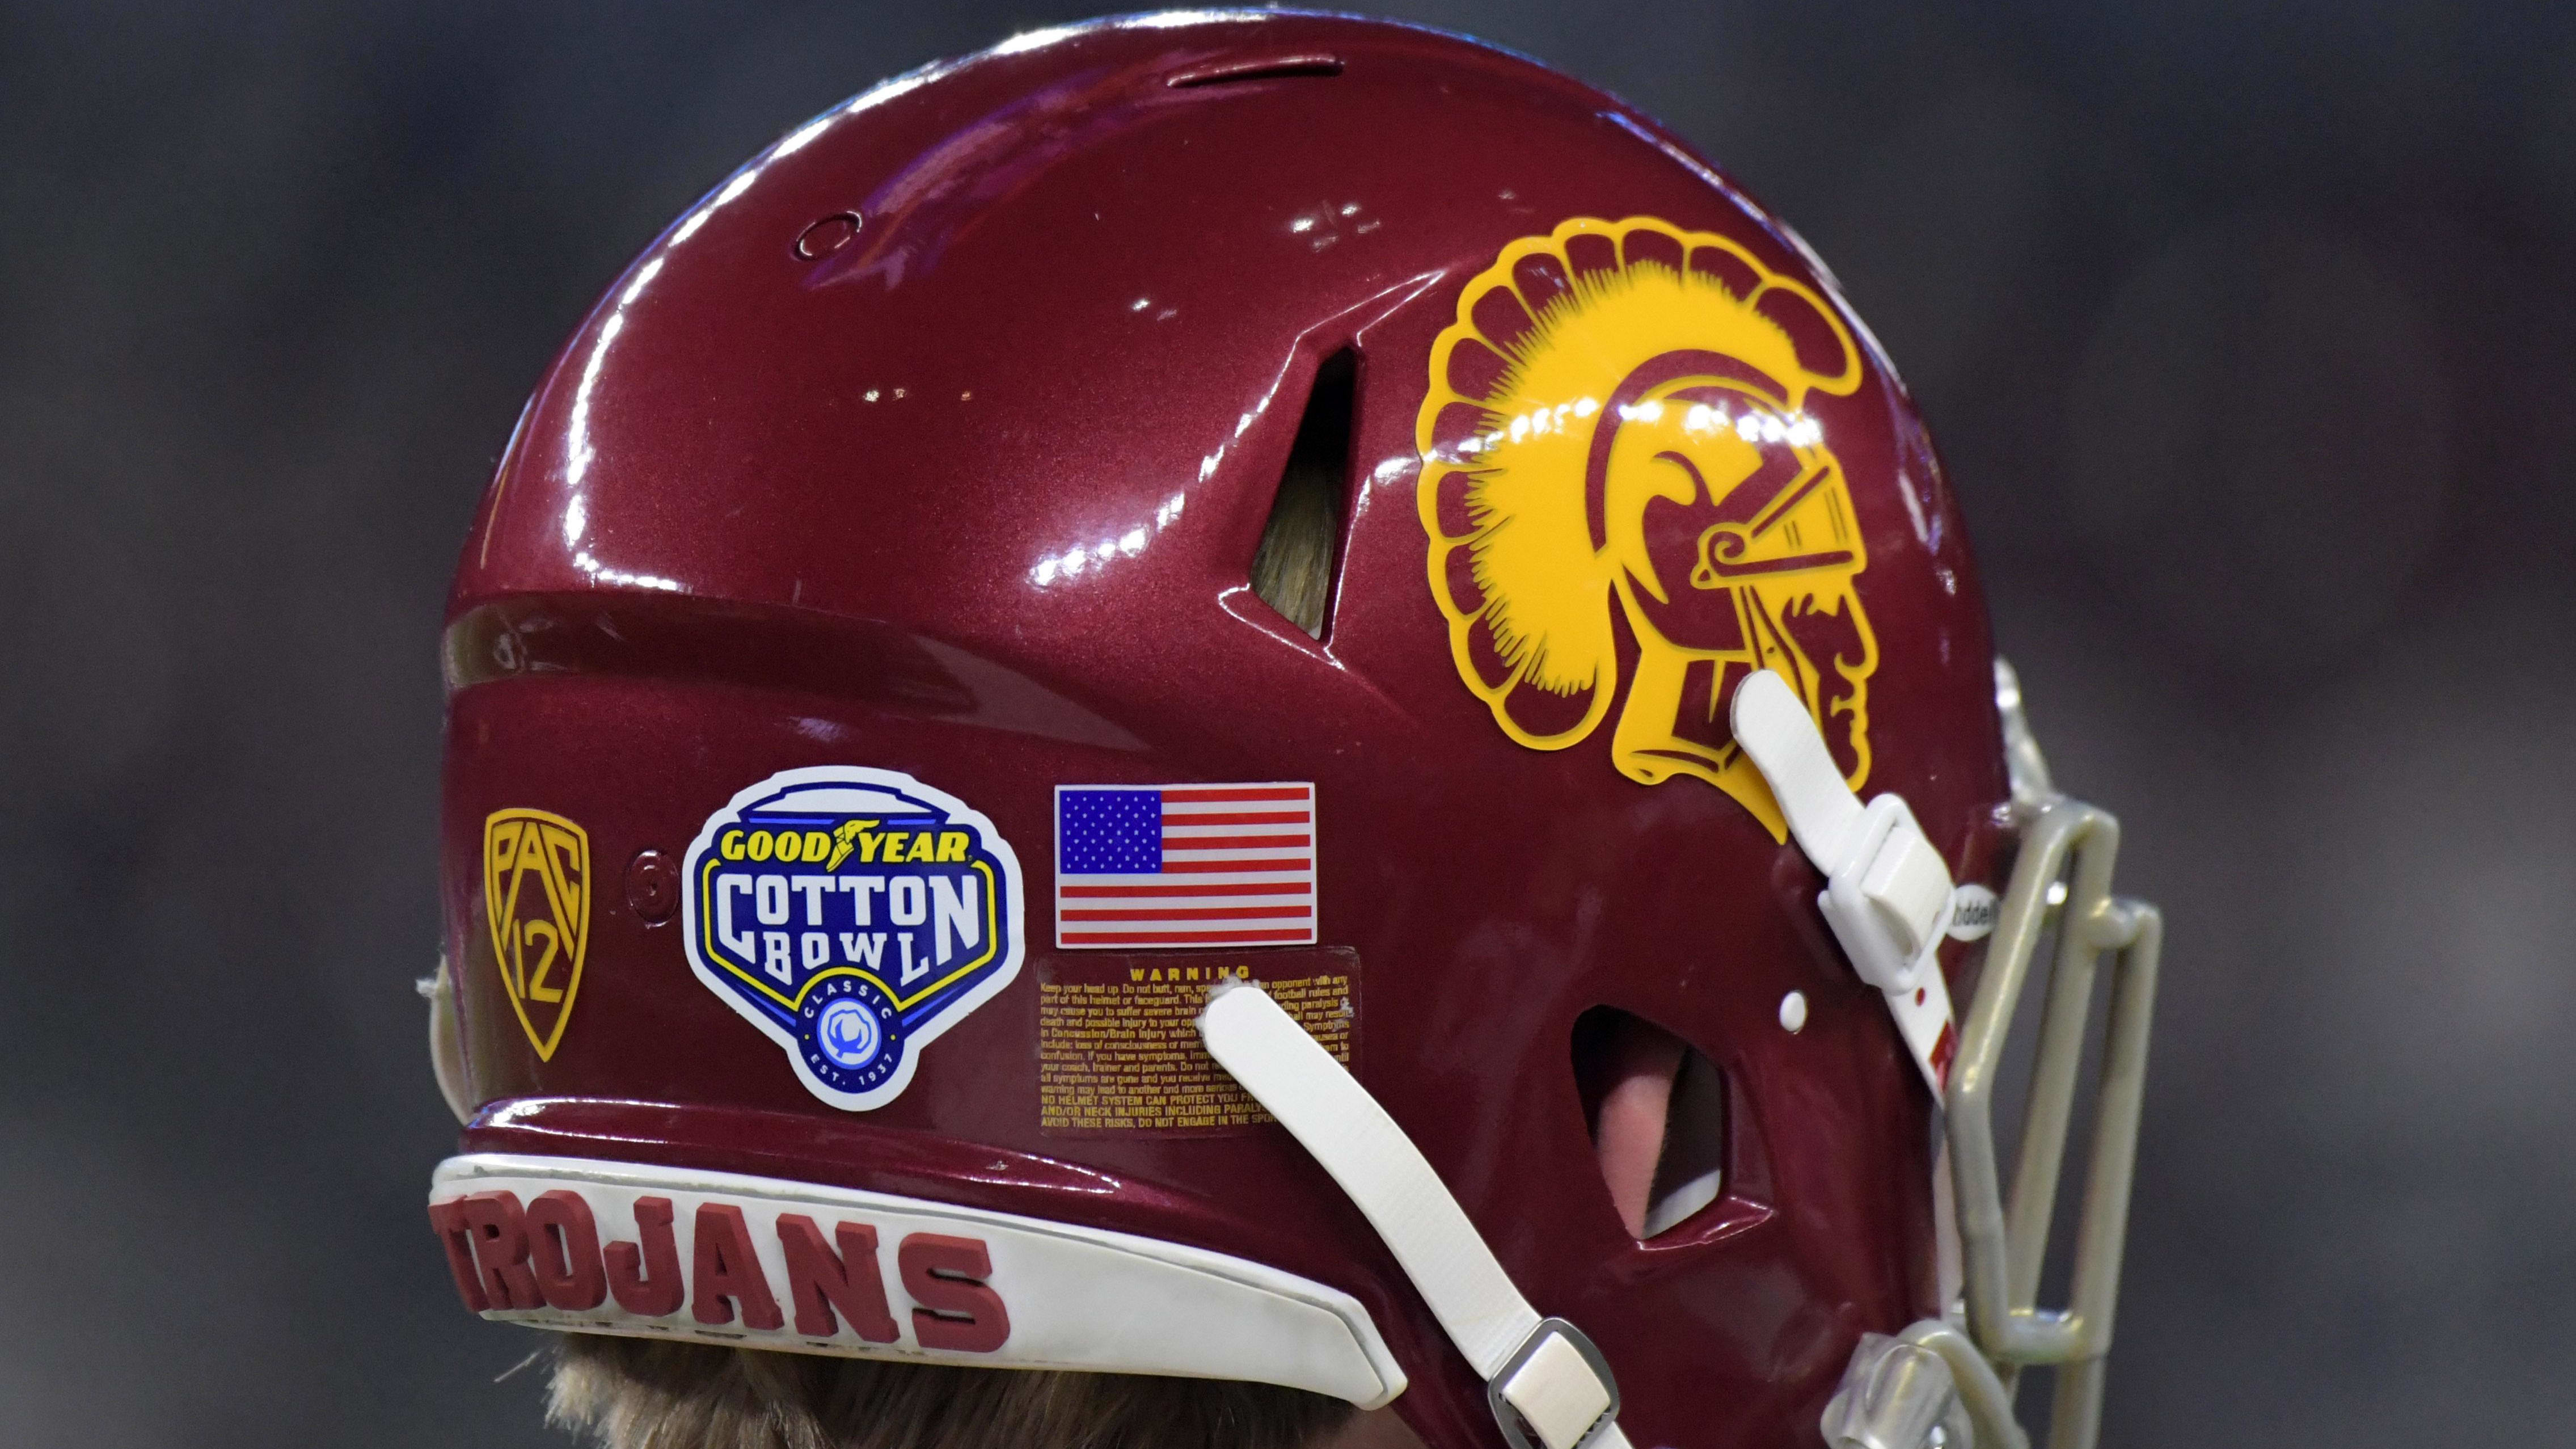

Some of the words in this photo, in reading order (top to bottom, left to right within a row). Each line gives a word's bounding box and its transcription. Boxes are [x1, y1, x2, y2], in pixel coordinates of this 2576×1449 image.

[489, 821, 580, 962] PAC
[716, 873, 979, 966] COTTON
[513, 918, 563, 1004] 12
[763, 932, 929, 986] BOWL
[1130, 966, 1249, 981] WARNING
[1041, 983, 1062, 994] Keep
[1063, 984, 1082, 995] your
[1084, 983, 1105, 993] head
[1123, 983, 1135, 992] Do
[1272, 978, 1311, 989] opponent
[1333, 975, 1348, 985] any
[804, 980, 893, 1019] CLASSIC
[1040, 996, 1058, 1006] part
[1059, 995, 1070, 1004] of
[1071, 995, 1087, 1004] this
[1089, 995, 1120, 1004] helmet
[1184, 994, 1203, 1004] This
[1274, 988, 1306, 1000] football
[1309, 987, 1330, 997] rules
[1333, 985, 1348, 995] and
[1041, 1007, 1058, 1017] may
[1088, 1008, 1104, 1018] you
[1106, 1006, 1114, 1016] to
[1117, 1006, 1140, 1016] suffer
[1175, 1006, 1196, 1015] brain
[1302, 998, 1338, 1010] paralysis
[1040, 1018, 1064, 1027] death
[1067, 1018, 1082, 1026] and
[1085, 1018, 1120, 1029] possible
[1160, 1020, 1179, 1029] your
[1306, 1012, 1323, 1021] may
[1051, 1028, 1135, 1038] Concussion/Brain
[1169, 1028, 1196, 1038] which
[1094, 1039, 1103, 1049] of
[1105, 1039, 1167, 1050] consciousness
[1096, 1053, 1111, 1062] you
[1114, 1051, 1135, 1060] have
[1138, 1052, 1187, 1062] symptoms,
[1341, 1042, 1349, 1051] to
[810, 1054, 847, 1086] EST.
[859, 1054, 893, 1086] 1937
[1041, 1064, 1059, 1073] your
[1062, 1063, 1089, 1072] coach,
[1123, 1063, 1139, 1072] and
[1142, 1063, 1177, 1073] parents.
[1180, 1062, 1193, 1071] Do
[1195, 1062, 1209, 1071] not
[1041, 1073, 1051, 1082] all
[1053, 1074, 1098, 1084] symptoms
[1117, 1076, 1139, 1085] gone
[1141, 1074, 1158, 1083] and
[1160, 1076, 1176, 1084] you
[1041, 1085, 1075, 1096] warning
[1078, 1086, 1095, 1096] may
[1097, 1085, 1115, 1094] lead
[1118, 1085, 1126, 1094] to
[1128, 1085, 1161, 1094] another
[1163, 1084, 1179, 1093] and
[1041, 1096, 1055, 1105] NO
[1058, 1095, 1098, 1105] HELMET
[1101, 1096, 1142, 1105] SYSTEM
[1146, 1096, 1166, 1105] CAN
[1170, 1094, 1214, 1104] PROTECT
[1218, 1093, 1238, 1102] YOU
[1041, 1106, 1080, 1116] AND/OR
[1084, 1107, 1112, 1116] NECK
[1115, 1106, 1162, 1116] INJURIES
[1165, 1105, 1221, 1115] INCLUDING
[1041, 1117, 1069, 1127] AVOID
[1072, 1118, 1102, 1127] THESE
[1105, 1118, 1135, 1128] RISKS,
[1138, 1118, 1152, 1127] DO
[1155, 1117, 1174, 1127] NOT
[1177, 1116, 1215, 1127] ENGAGE
[1219, 1115, 1228, 1126] IN
[1230, 1114, 1249, 1124] THE
[428, 1189, 1011, 1353] TROJANS
